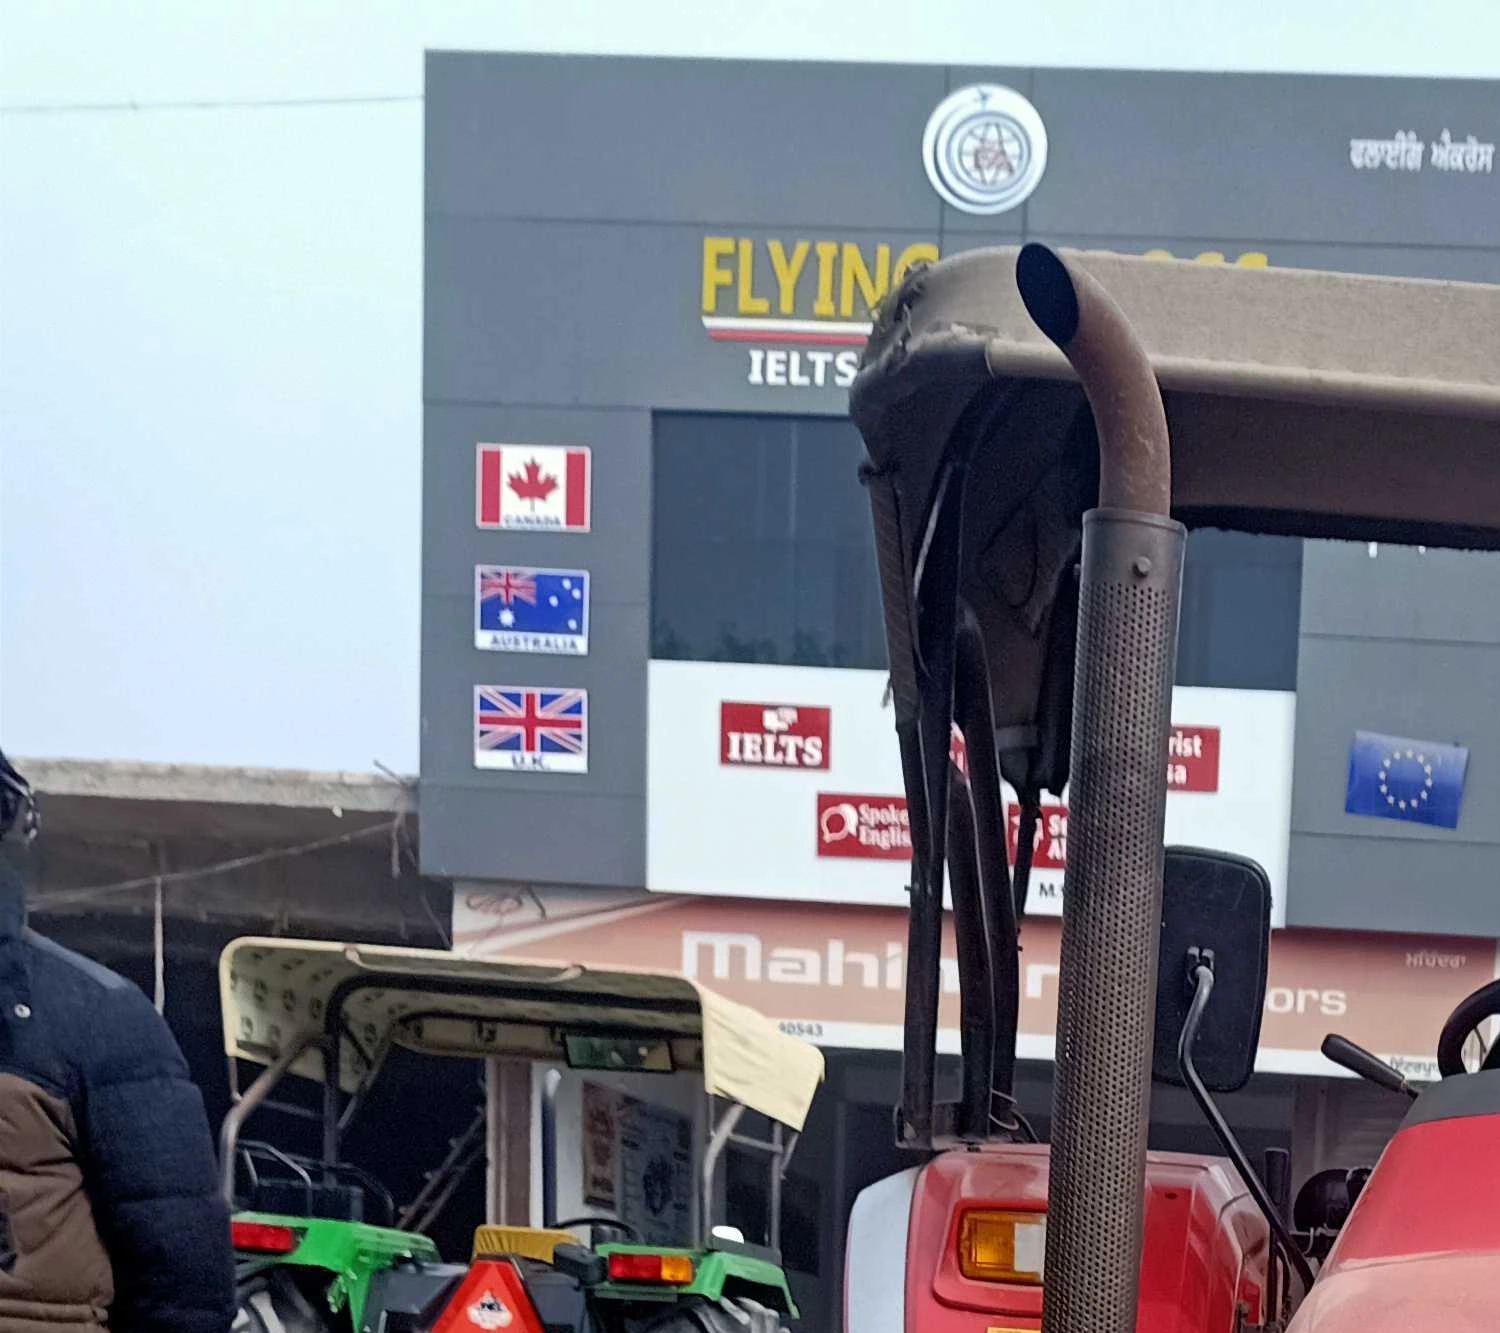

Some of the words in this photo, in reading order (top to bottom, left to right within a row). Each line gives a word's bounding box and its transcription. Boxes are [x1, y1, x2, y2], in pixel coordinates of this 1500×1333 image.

[748, 349, 858, 387] IELTS
[490, 635, 578, 650] AUSTRALIA
[727, 731, 823, 766] IELTS
[859, 803, 909, 828] Spoke
